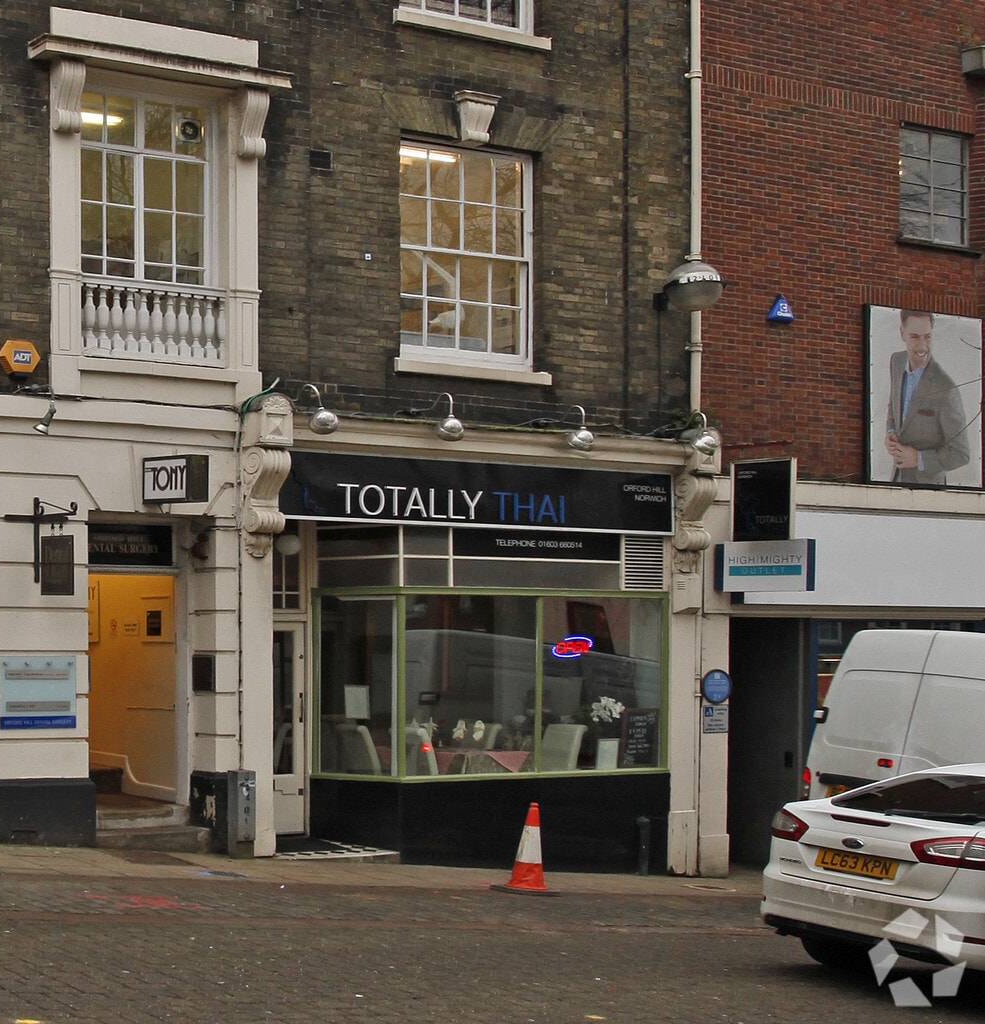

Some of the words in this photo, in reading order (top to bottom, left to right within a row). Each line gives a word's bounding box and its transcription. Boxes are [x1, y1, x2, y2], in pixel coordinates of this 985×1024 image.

[14, 352, 32, 361] ADT
[145, 465, 187, 491] TONY
[623, 484, 651, 492] ORFORD
[652, 486, 666, 494] HILL
[635, 494, 666, 502] NORWICH
[337, 483, 483, 520] TOTALLY
[492, 490, 565, 524] THAI
[755, 515, 788, 524] TOTALLY
[496, 539, 536, 548] TELEPHONE
[728, 556, 755, 565] HIGH
[760, 555, 802, 565] MIGHTY
[741, 567, 785, 575] OUTLET
[821, 851, 859, 869] LC63
[861, 857, 892, 876] KPN
